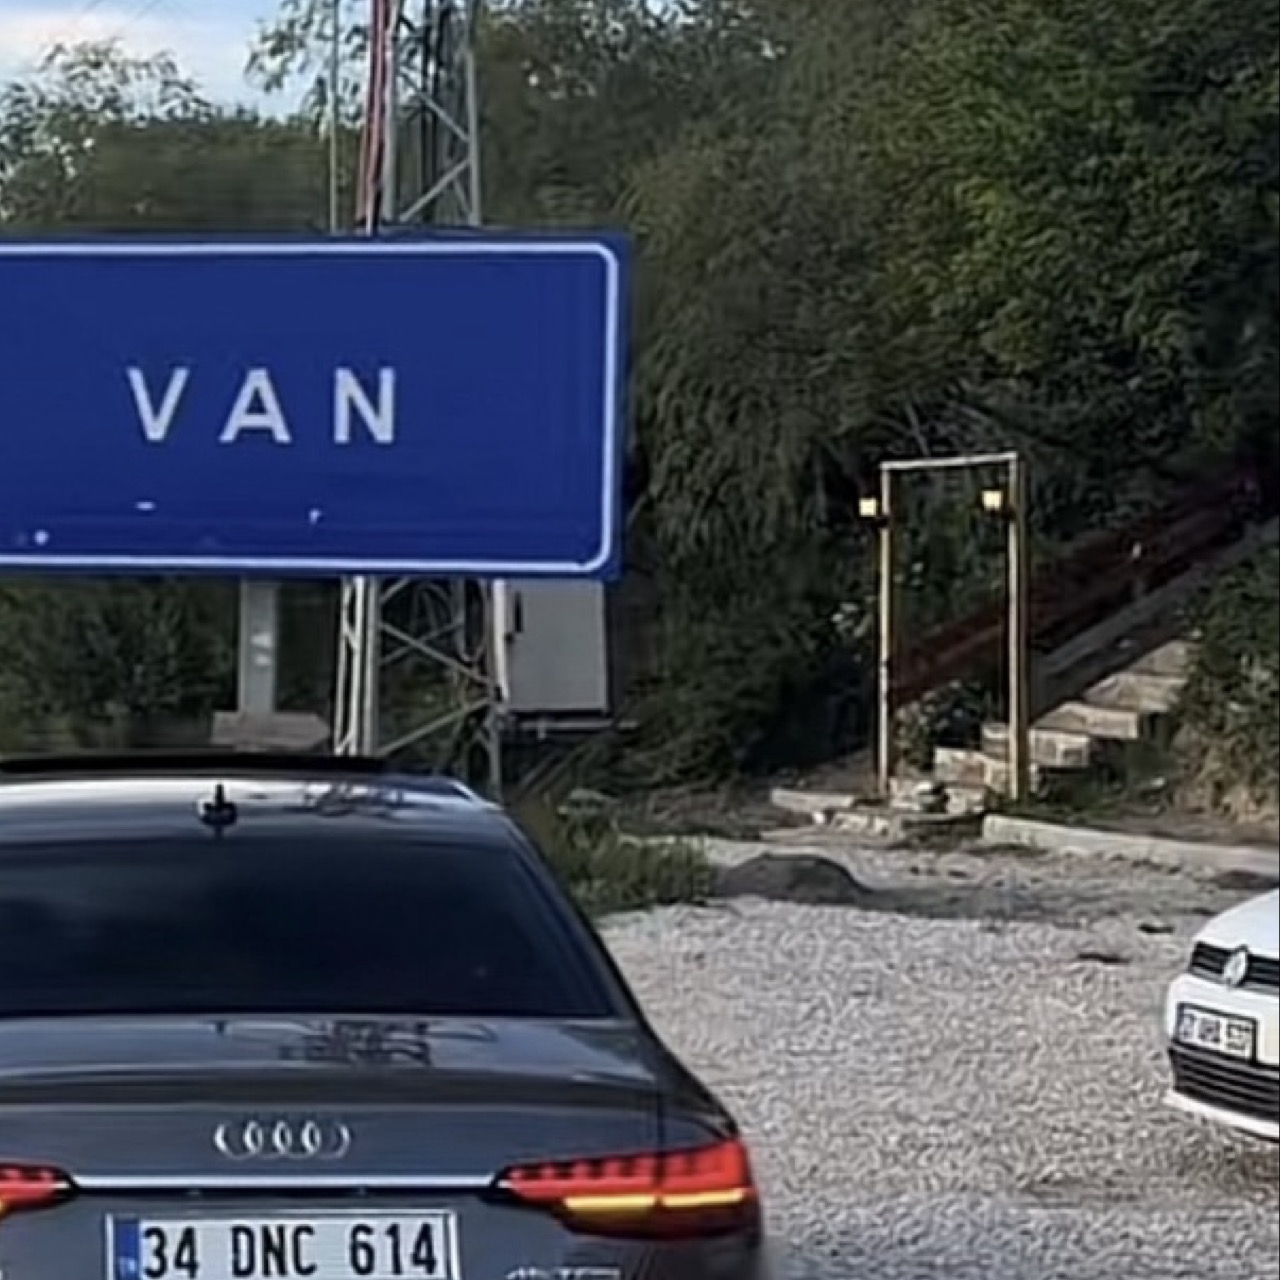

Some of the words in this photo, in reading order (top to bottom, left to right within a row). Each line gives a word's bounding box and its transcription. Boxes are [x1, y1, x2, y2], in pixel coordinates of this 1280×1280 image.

[126, 367, 397, 444] VAN
[142, 1225, 200, 1280] 34
[230, 1224, 318, 1278] DNC
[348, 1222, 438, 1276] 614
